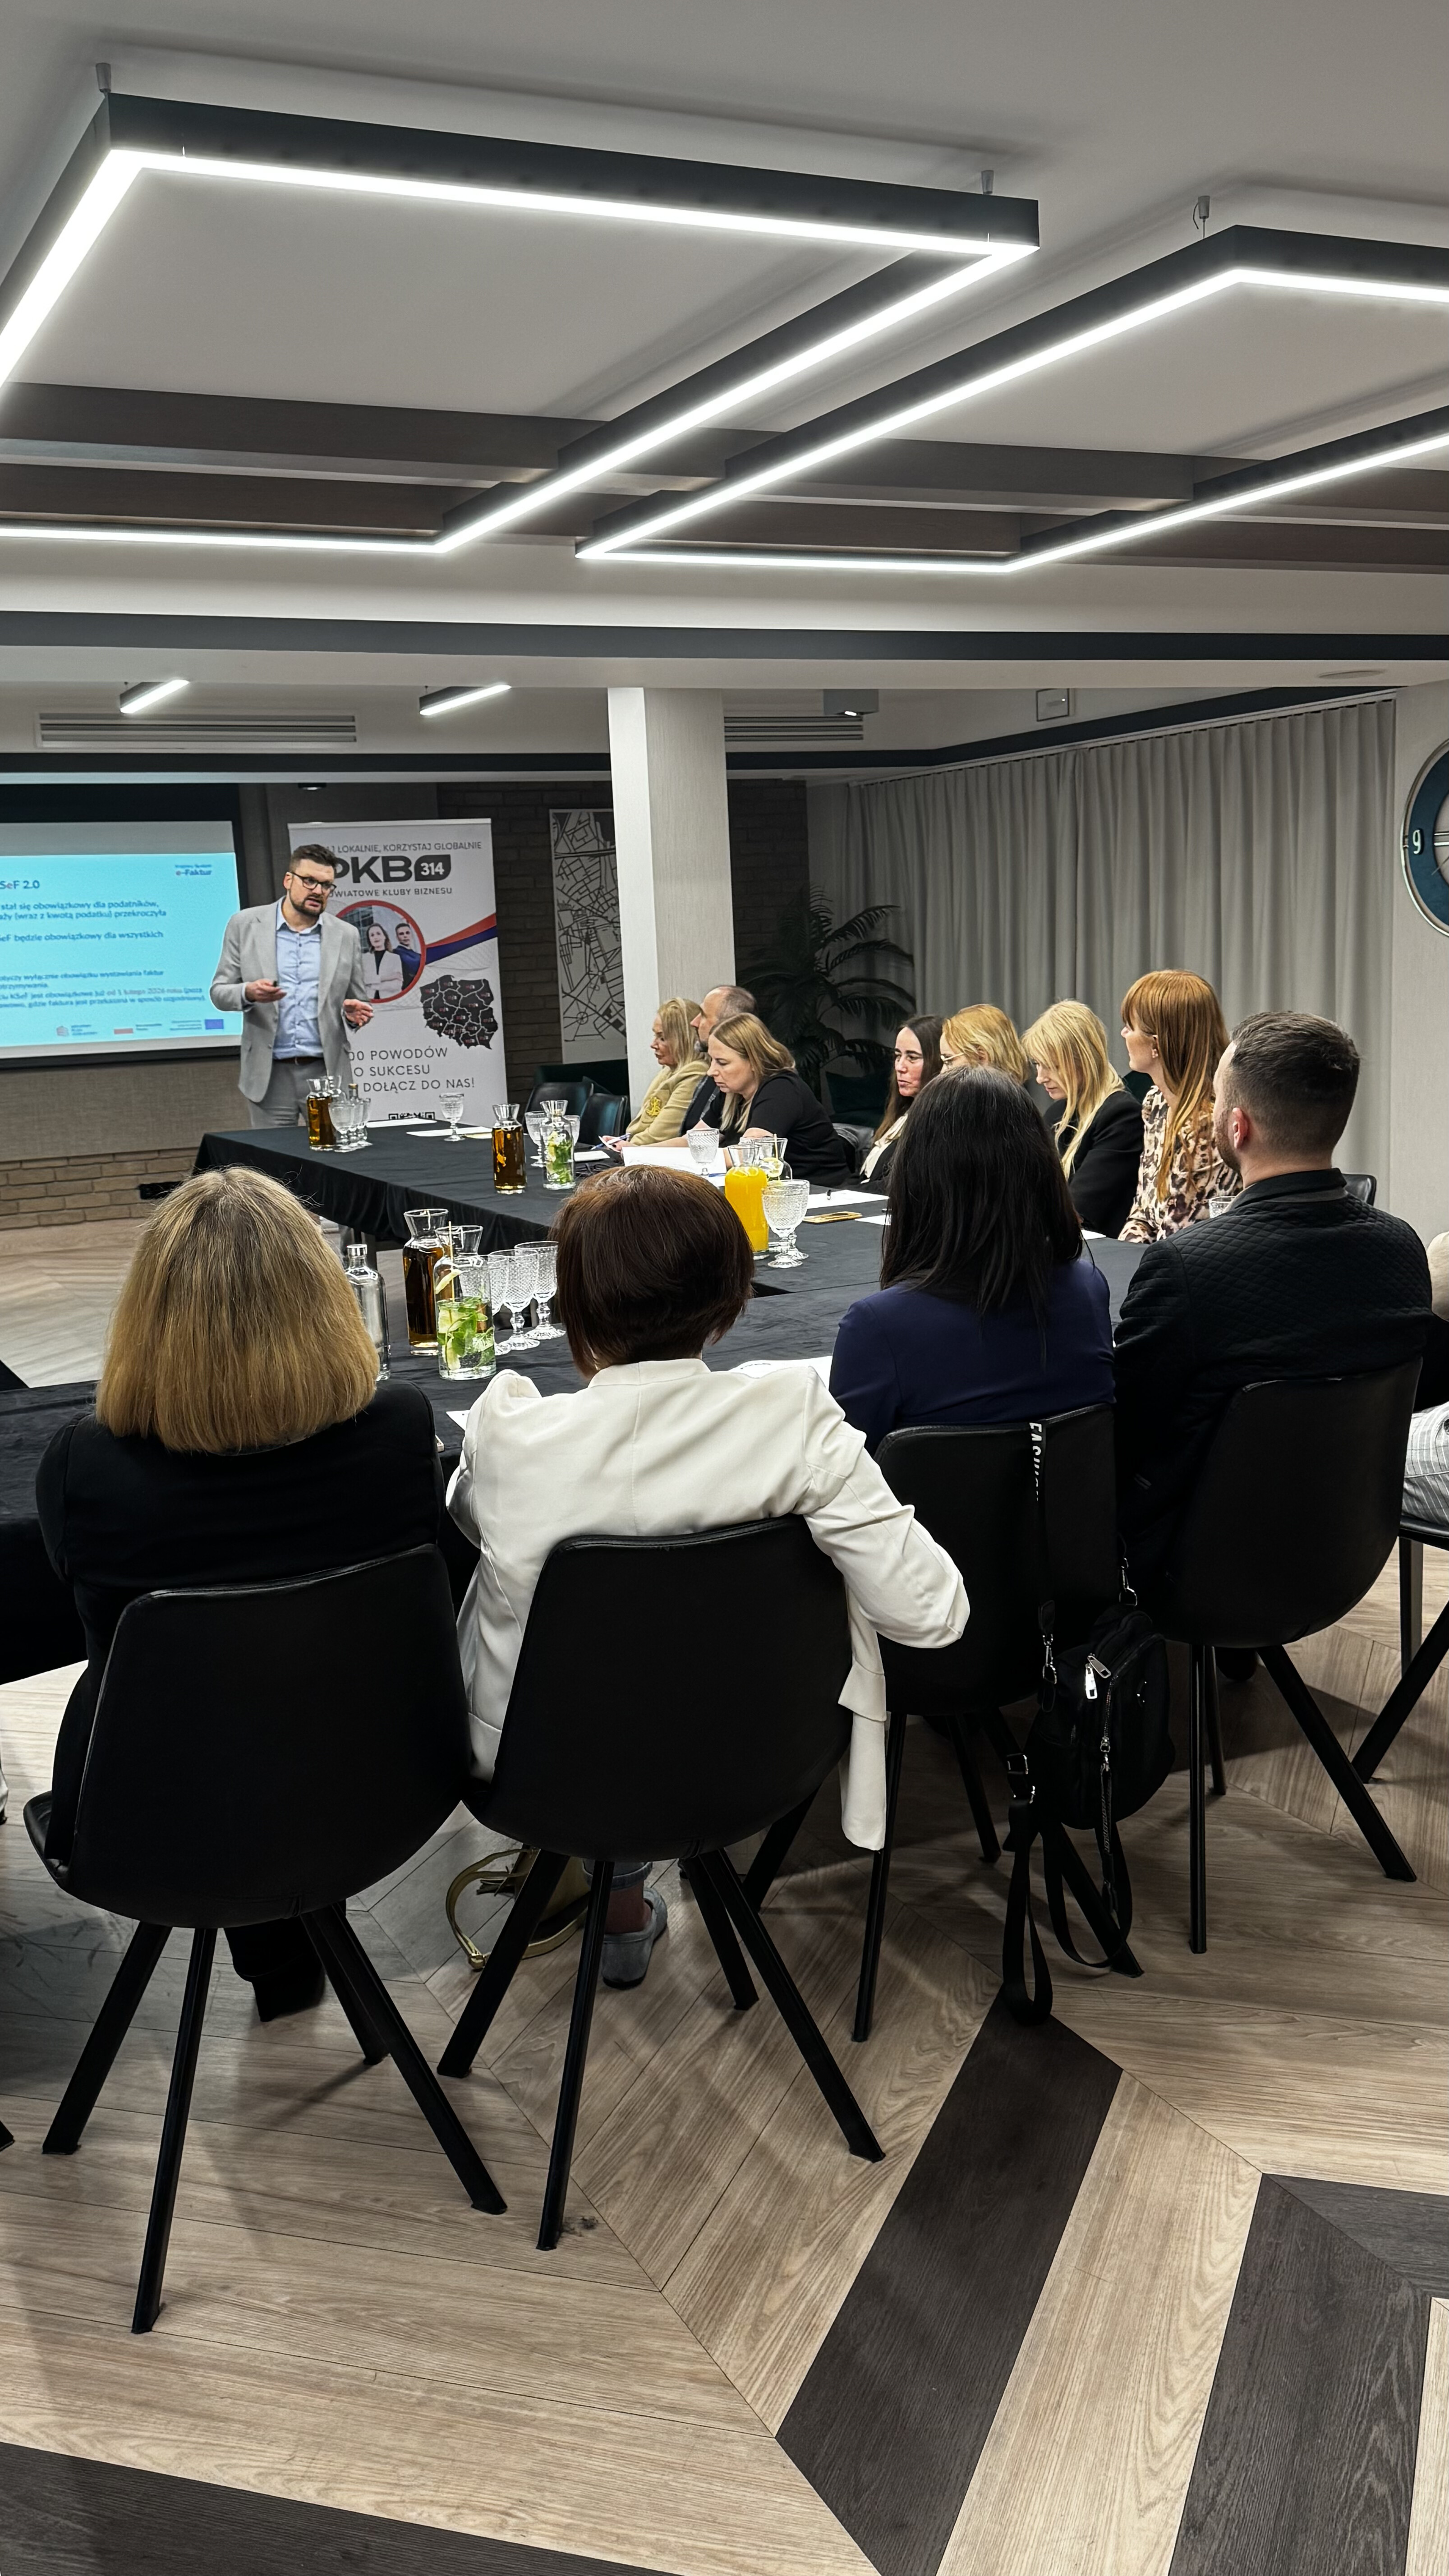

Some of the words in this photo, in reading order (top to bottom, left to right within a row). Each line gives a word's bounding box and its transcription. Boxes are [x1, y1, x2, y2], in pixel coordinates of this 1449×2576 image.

[337, 844, 382, 853] LOKALNIE,
[383, 843, 431, 851] KORZYSTAJ
[434, 842, 482, 851] GLOBALNIE
[1412, 829, 1421, 854] 9
[420, 862, 445, 876] 314
[23, 880, 40, 889] 2.0
[329, 889, 380, 897] OWIATOWE
[414, 887, 452, 895] BIZNESU
[370, 1045, 447, 1060] POWODÓW
[369, 1064, 430, 1076] SUKCESU
[363, 1081, 416, 1094] DOŁĄCZ
[421, 1080, 441, 1090] DO
[446, 1077, 474, 1088] NAS!
